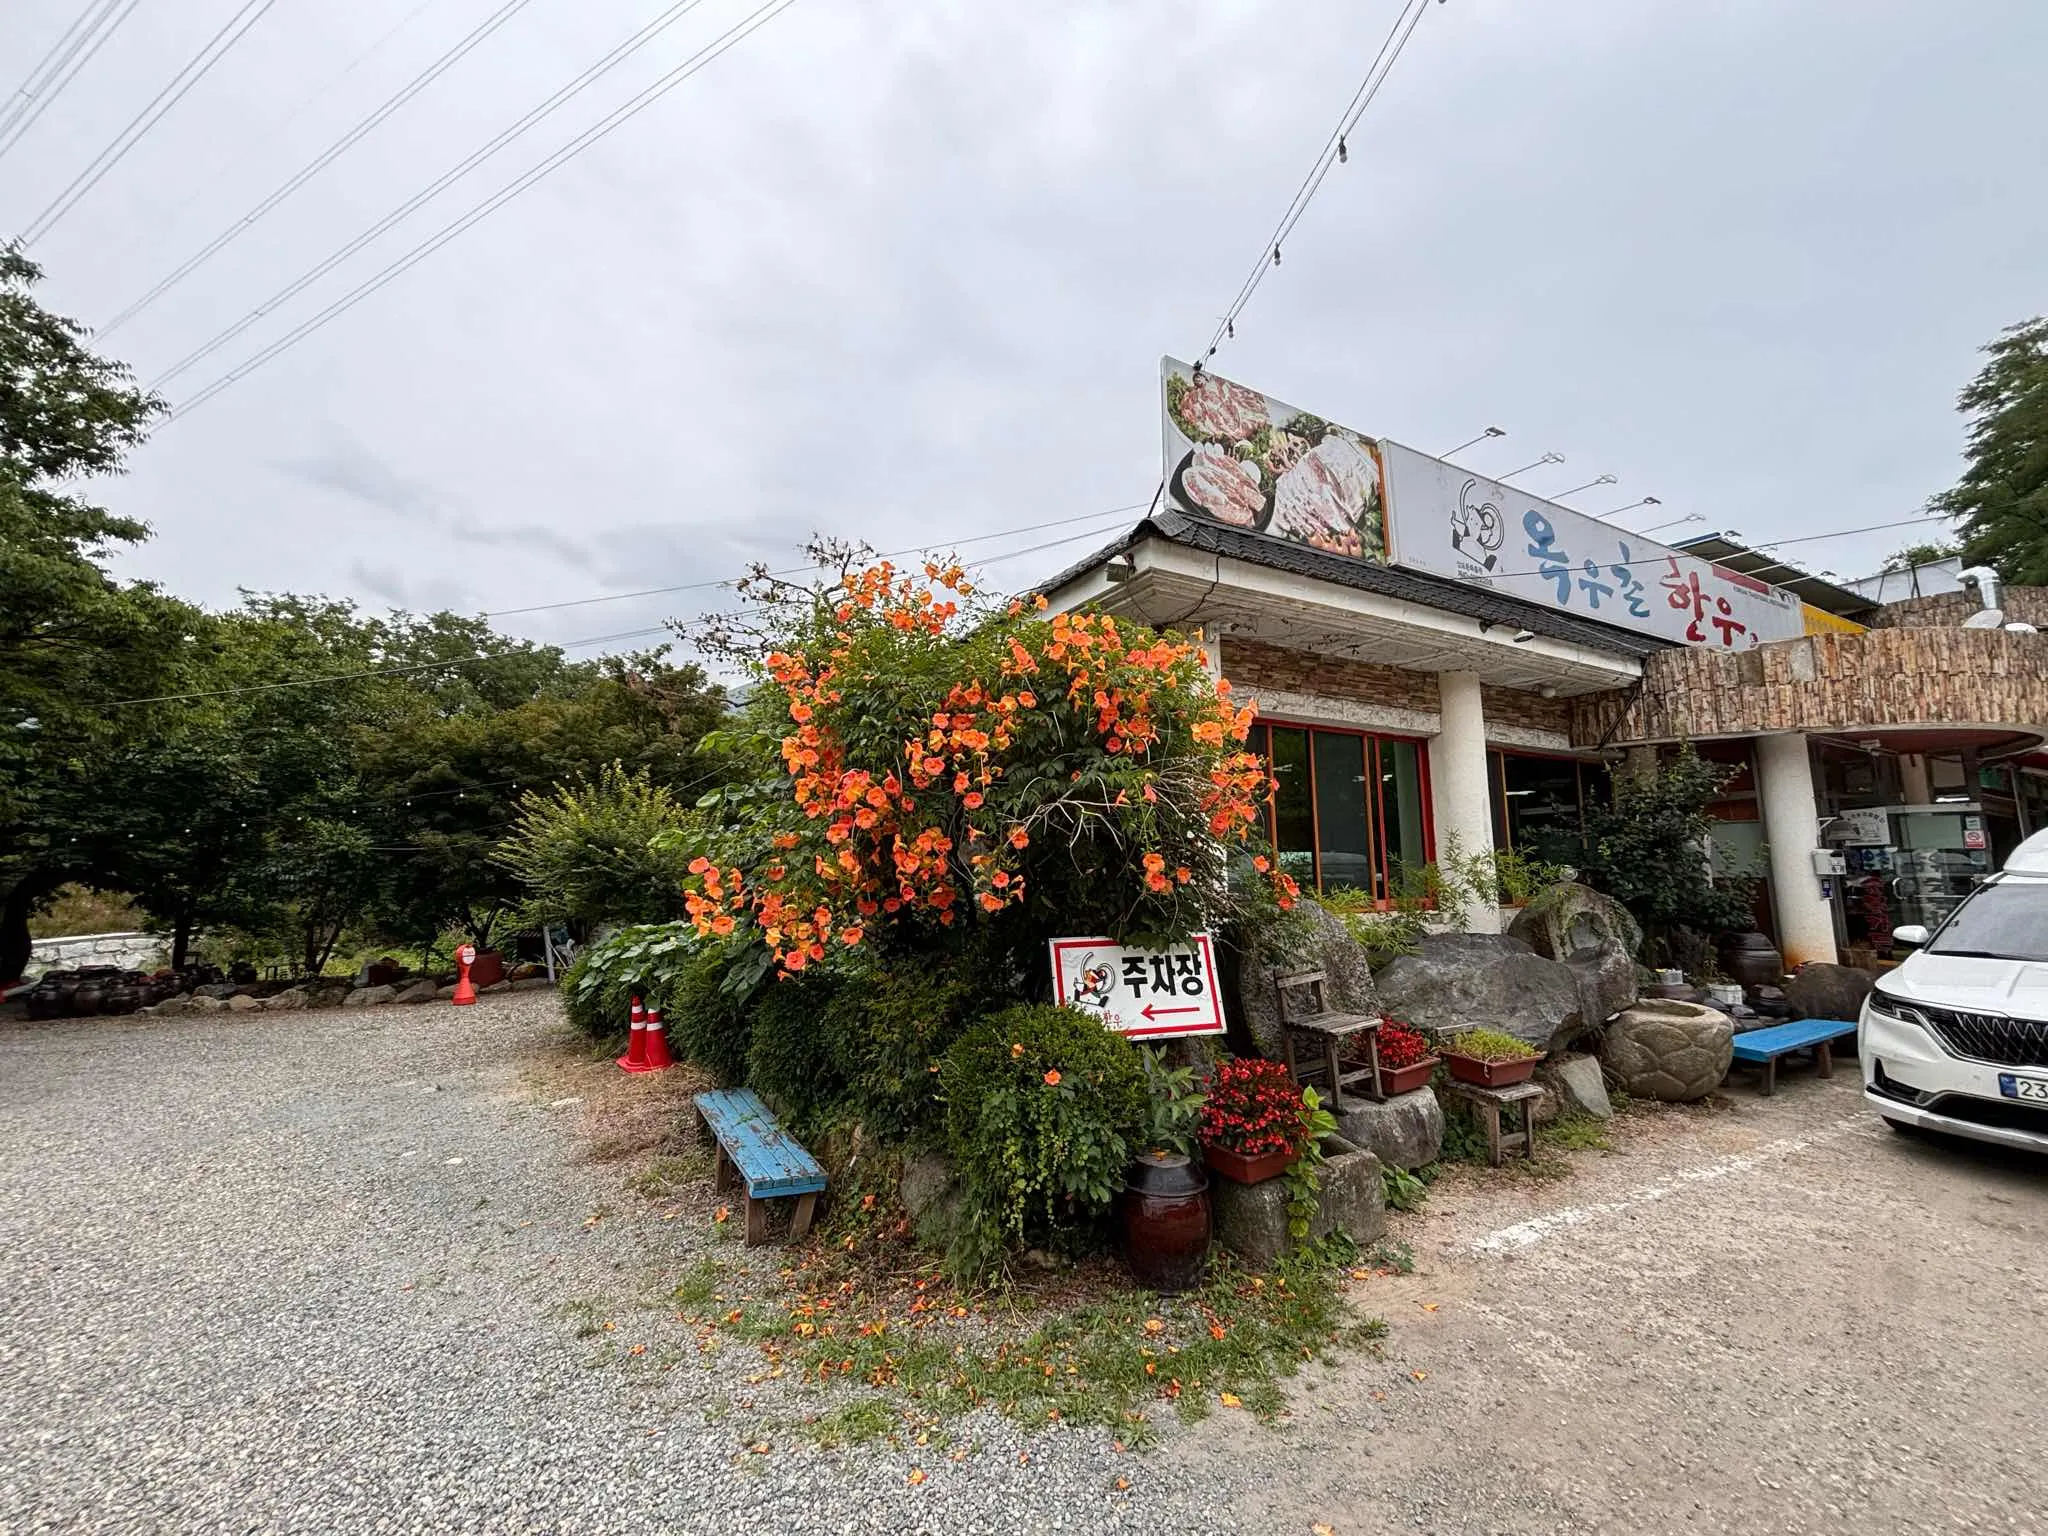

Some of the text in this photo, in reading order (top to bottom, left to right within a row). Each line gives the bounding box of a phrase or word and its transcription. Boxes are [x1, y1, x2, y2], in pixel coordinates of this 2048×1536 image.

[1659, 555, 1746, 646] 한우
[1122, 954, 1203, 998] 주차장
[2020, 1081, 2048, 1099] 23
